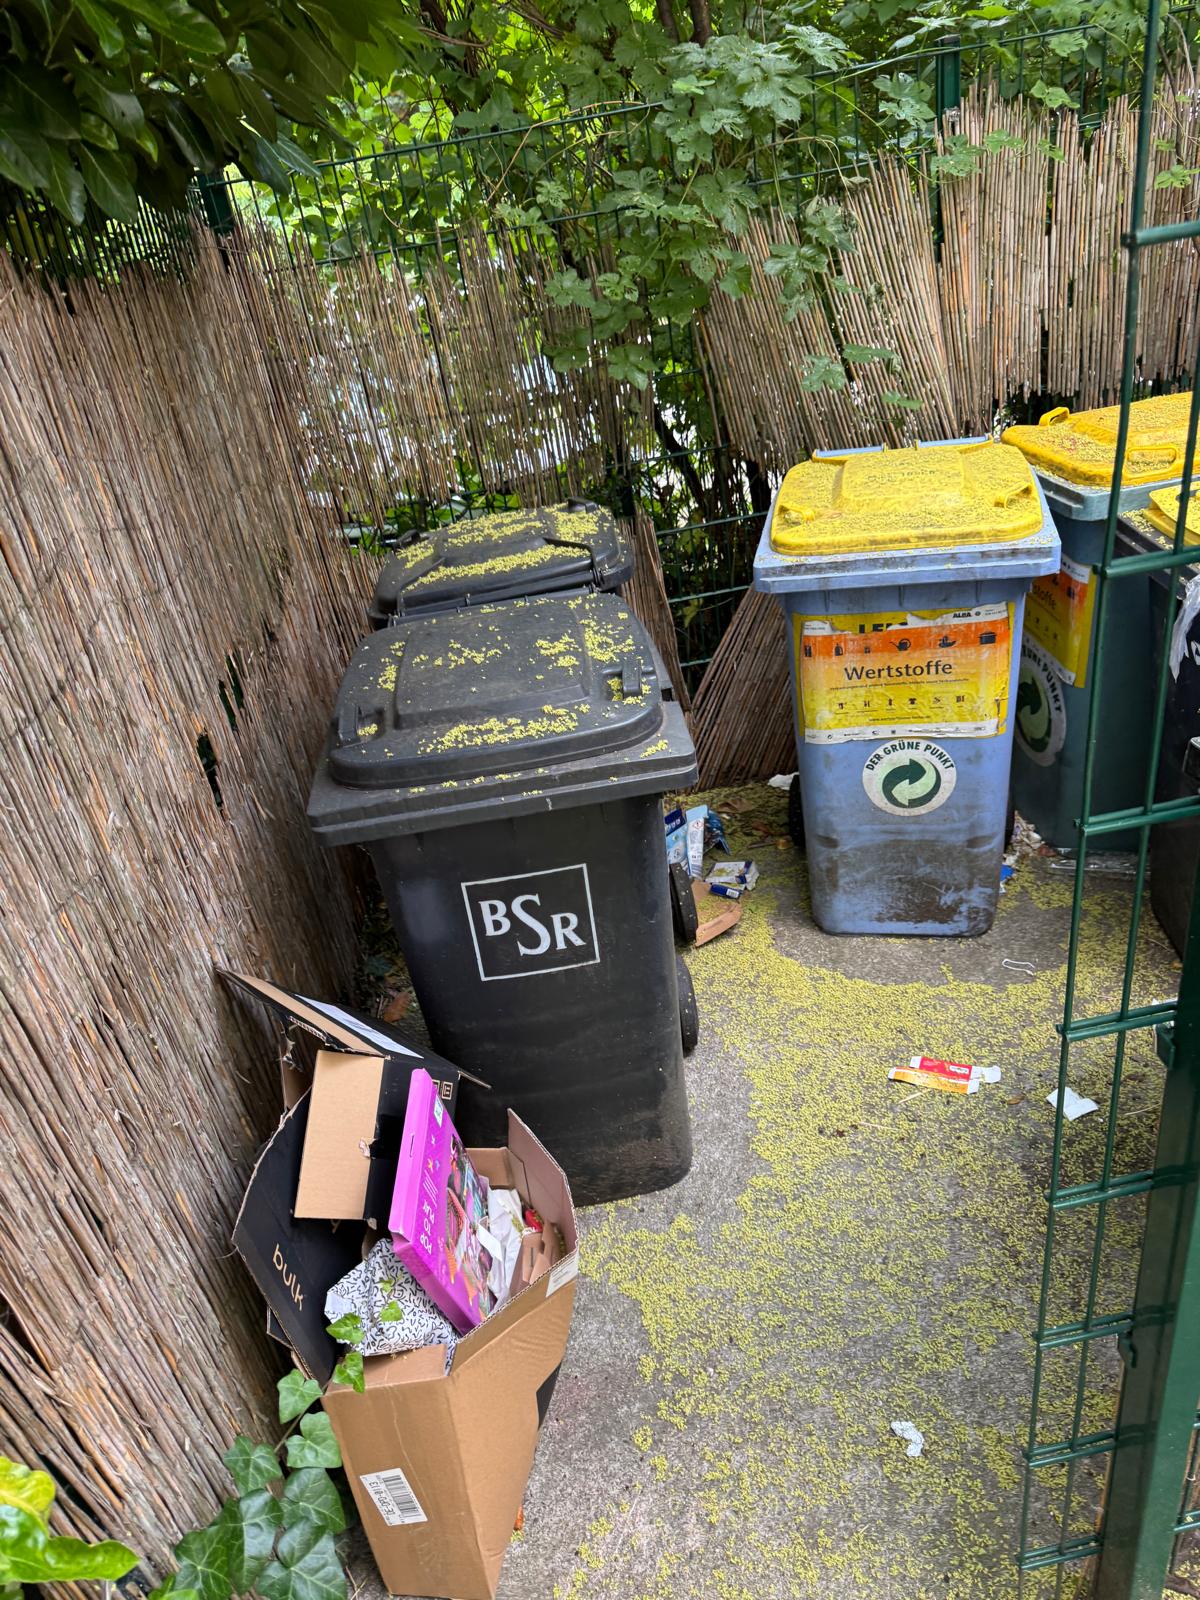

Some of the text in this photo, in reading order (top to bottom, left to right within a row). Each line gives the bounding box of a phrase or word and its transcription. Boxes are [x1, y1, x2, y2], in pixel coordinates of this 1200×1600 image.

[844, 659, 953, 681] Wertstoffe
[865, 740, 955, 772] DER GRÜNE PUNKT
[478, 893, 587, 957] BSR
[271, 1243, 304, 1311] bulk
